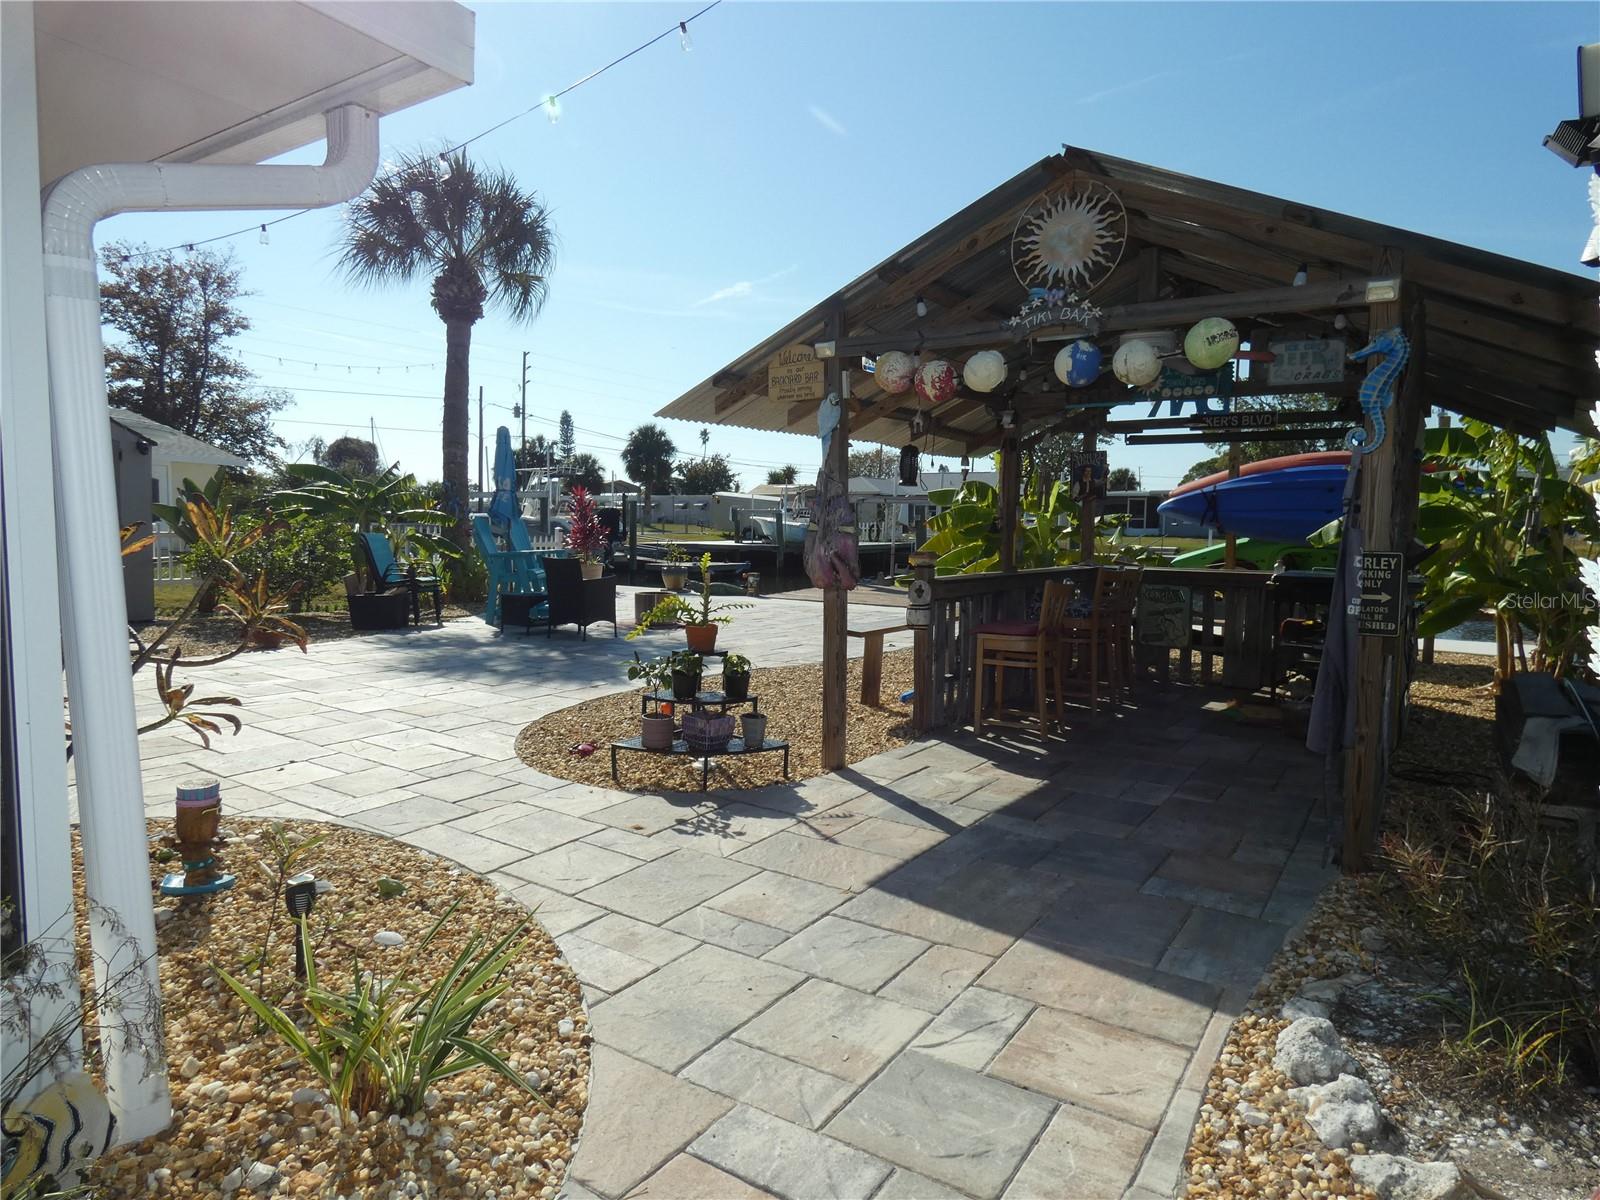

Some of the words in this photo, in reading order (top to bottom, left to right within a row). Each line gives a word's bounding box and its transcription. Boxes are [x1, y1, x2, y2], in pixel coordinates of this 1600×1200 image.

[1022, 311, 1052, 328] TIKI
[1060, 307, 1093, 326] BAR
[771, 373, 802, 385] BACKYARD
[805, 371, 819, 384] BAR
[1206, 415, 1239, 427] KER'S
[1242, 414, 1272, 426] BLVD
[1364, 557, 1397, 569] RLEY
[1362, 570, 1391, 579] RKING
[1364, 580, 1383, 588] NLY
[1361, 606, 1389, 614] LATORS
[1359, 621, 1396, 631] USHED
